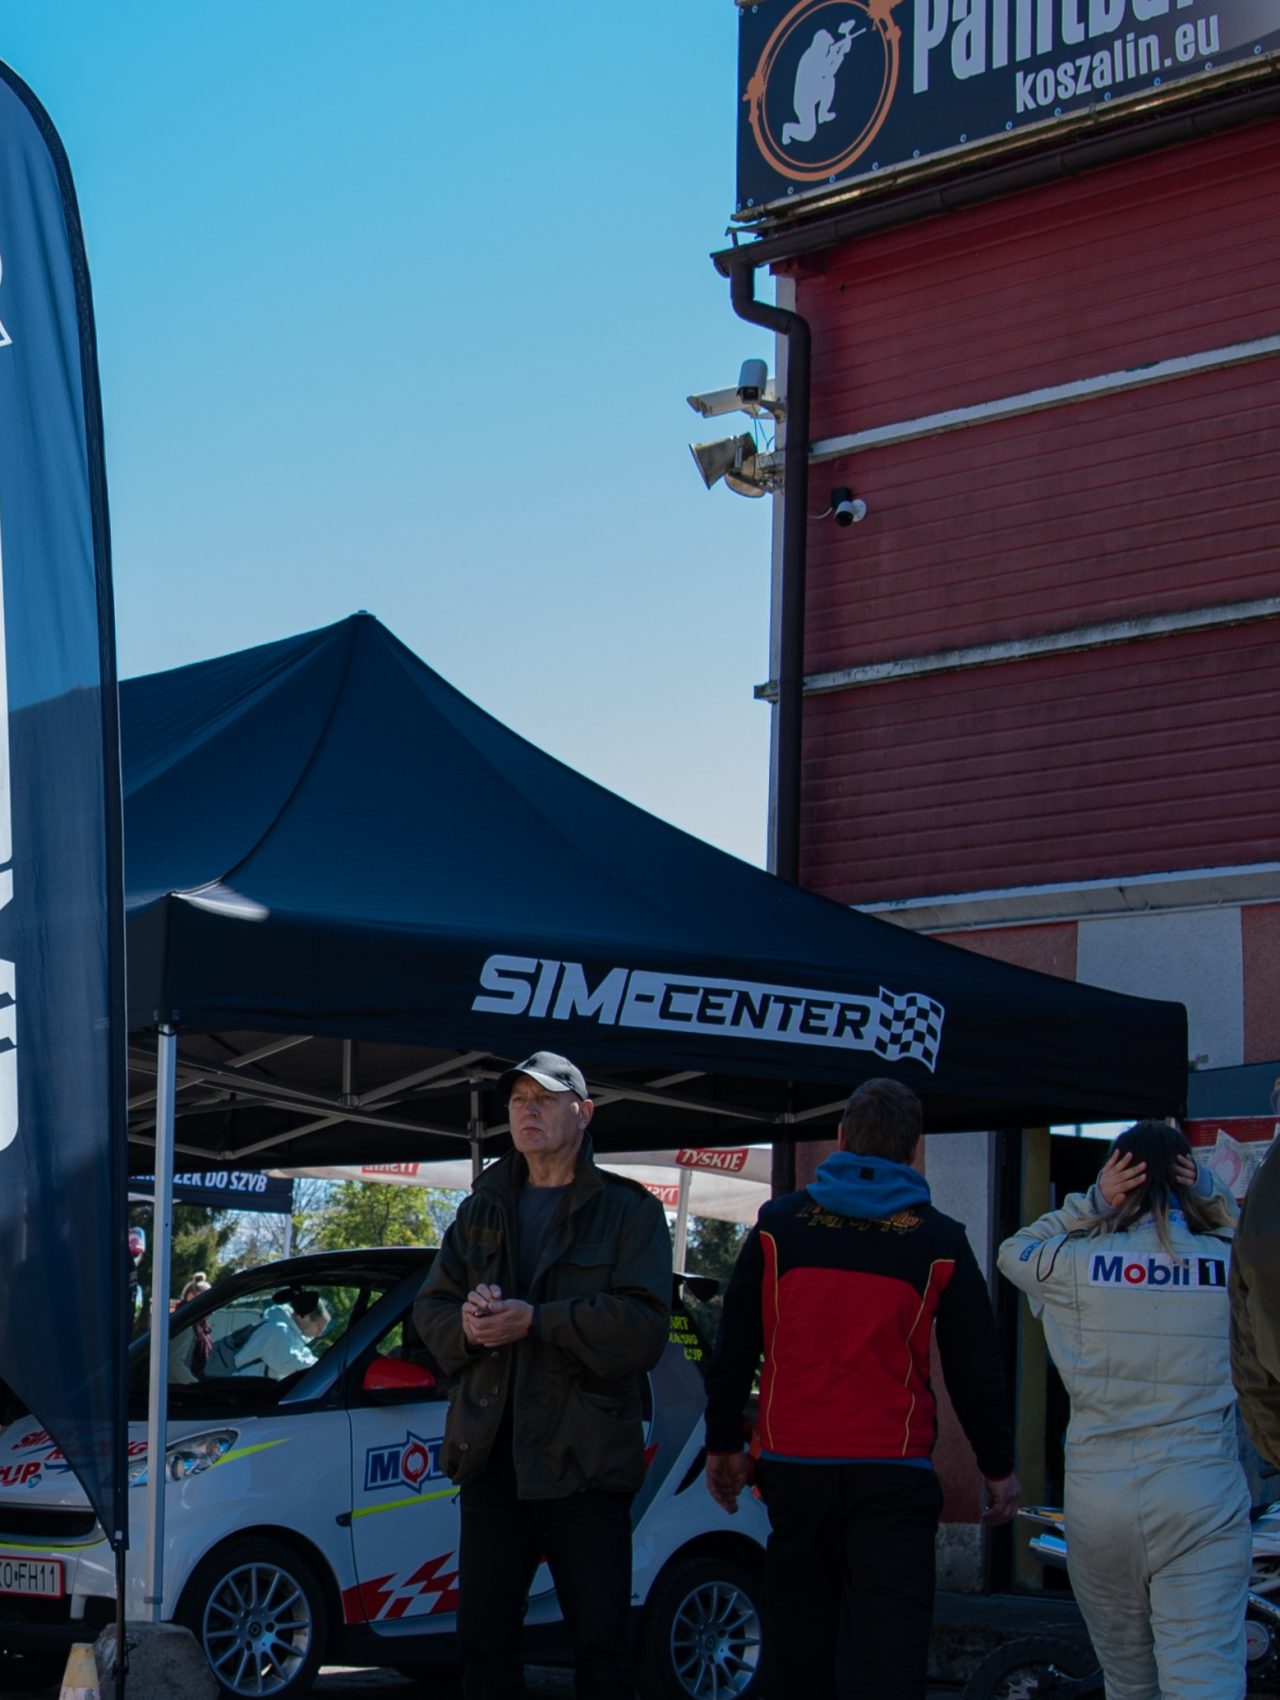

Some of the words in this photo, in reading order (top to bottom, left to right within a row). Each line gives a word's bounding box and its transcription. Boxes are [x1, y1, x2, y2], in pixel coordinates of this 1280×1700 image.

[1015, 14, 1221, 114] koszalin.eu
[471, 953, 872, 1042] SIM-CENTER
[681, 1149, 743, 1170] TYSKIE
[228, 1171, 268, 1193] SZYB
[1091, 1255, 1191, 1286] Mobil
[17, 1562, 57, 1593] FH11
